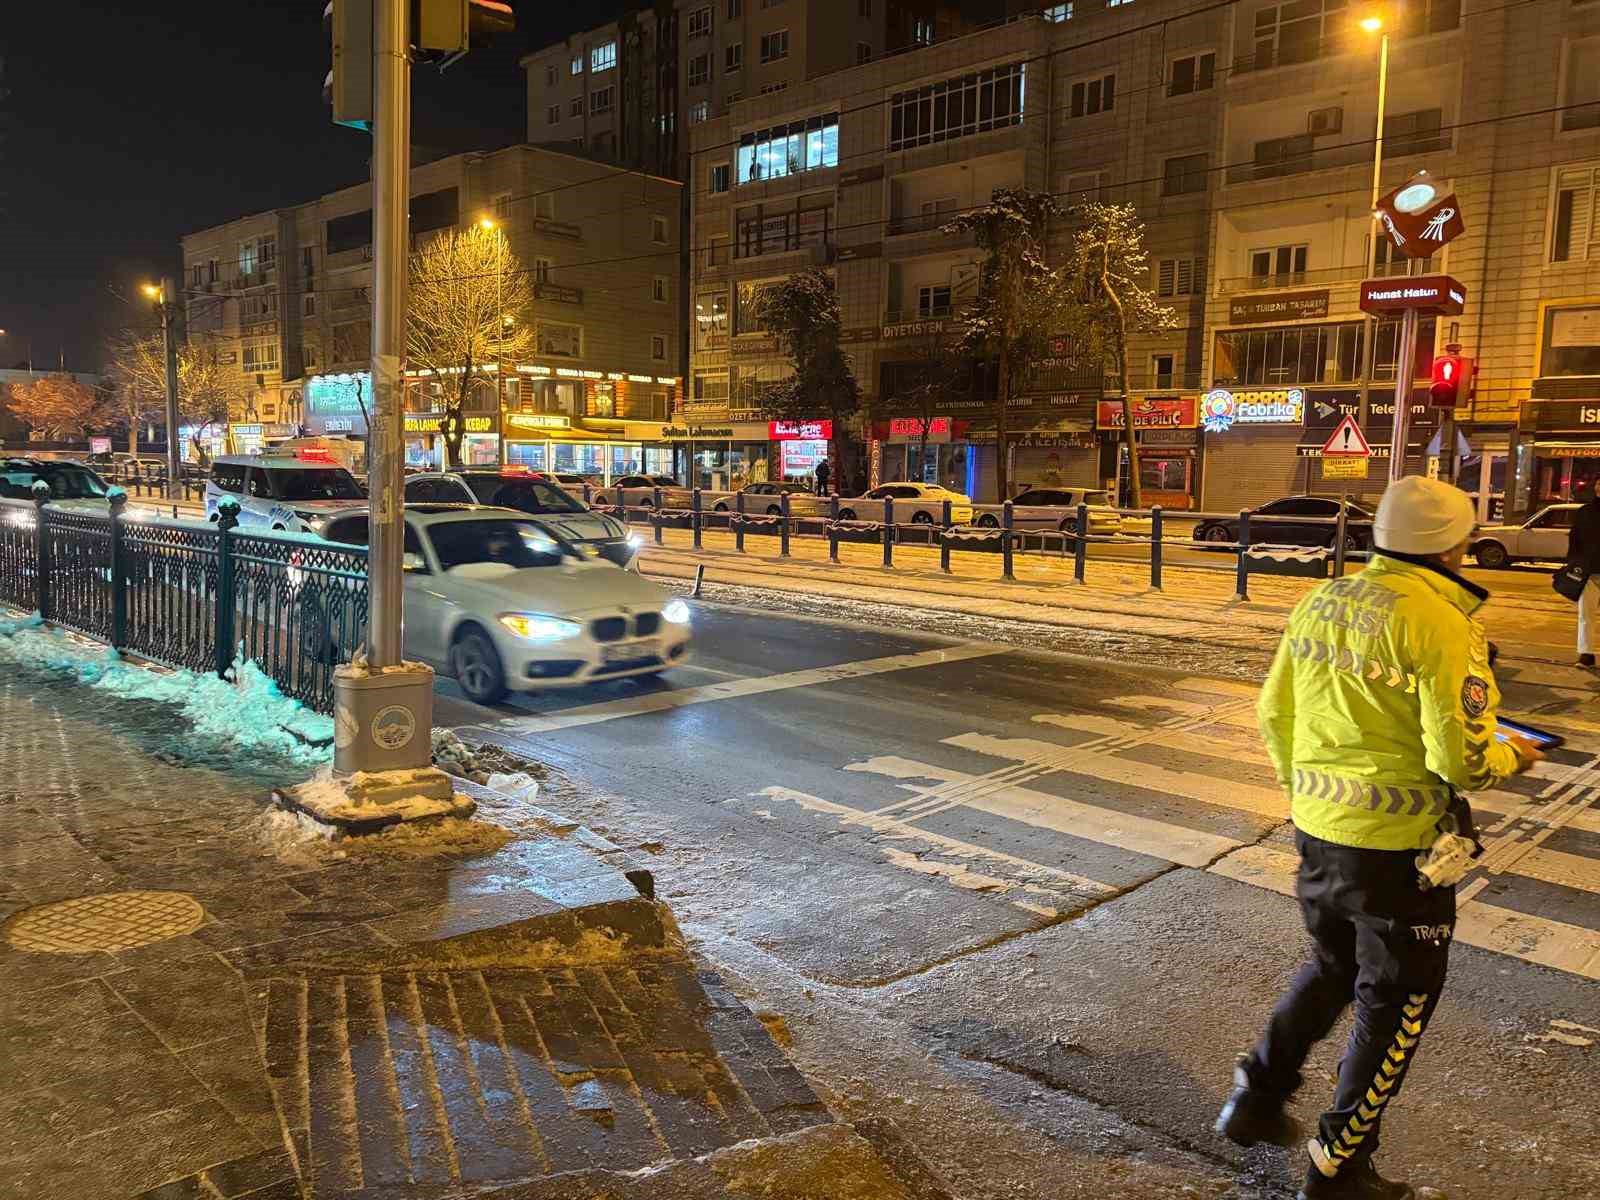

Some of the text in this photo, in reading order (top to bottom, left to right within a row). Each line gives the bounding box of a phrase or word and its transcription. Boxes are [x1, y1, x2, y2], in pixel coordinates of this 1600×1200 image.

[1239, 403, 1296, 416] Fabrika
[1339, 403, 1425, 415] Tür Telem
[465, 417, 491, 431] KEBAP
[662, 426, 733, 438] Sultan Lahmacun
[871, 439, 880, 490] ECZAN
